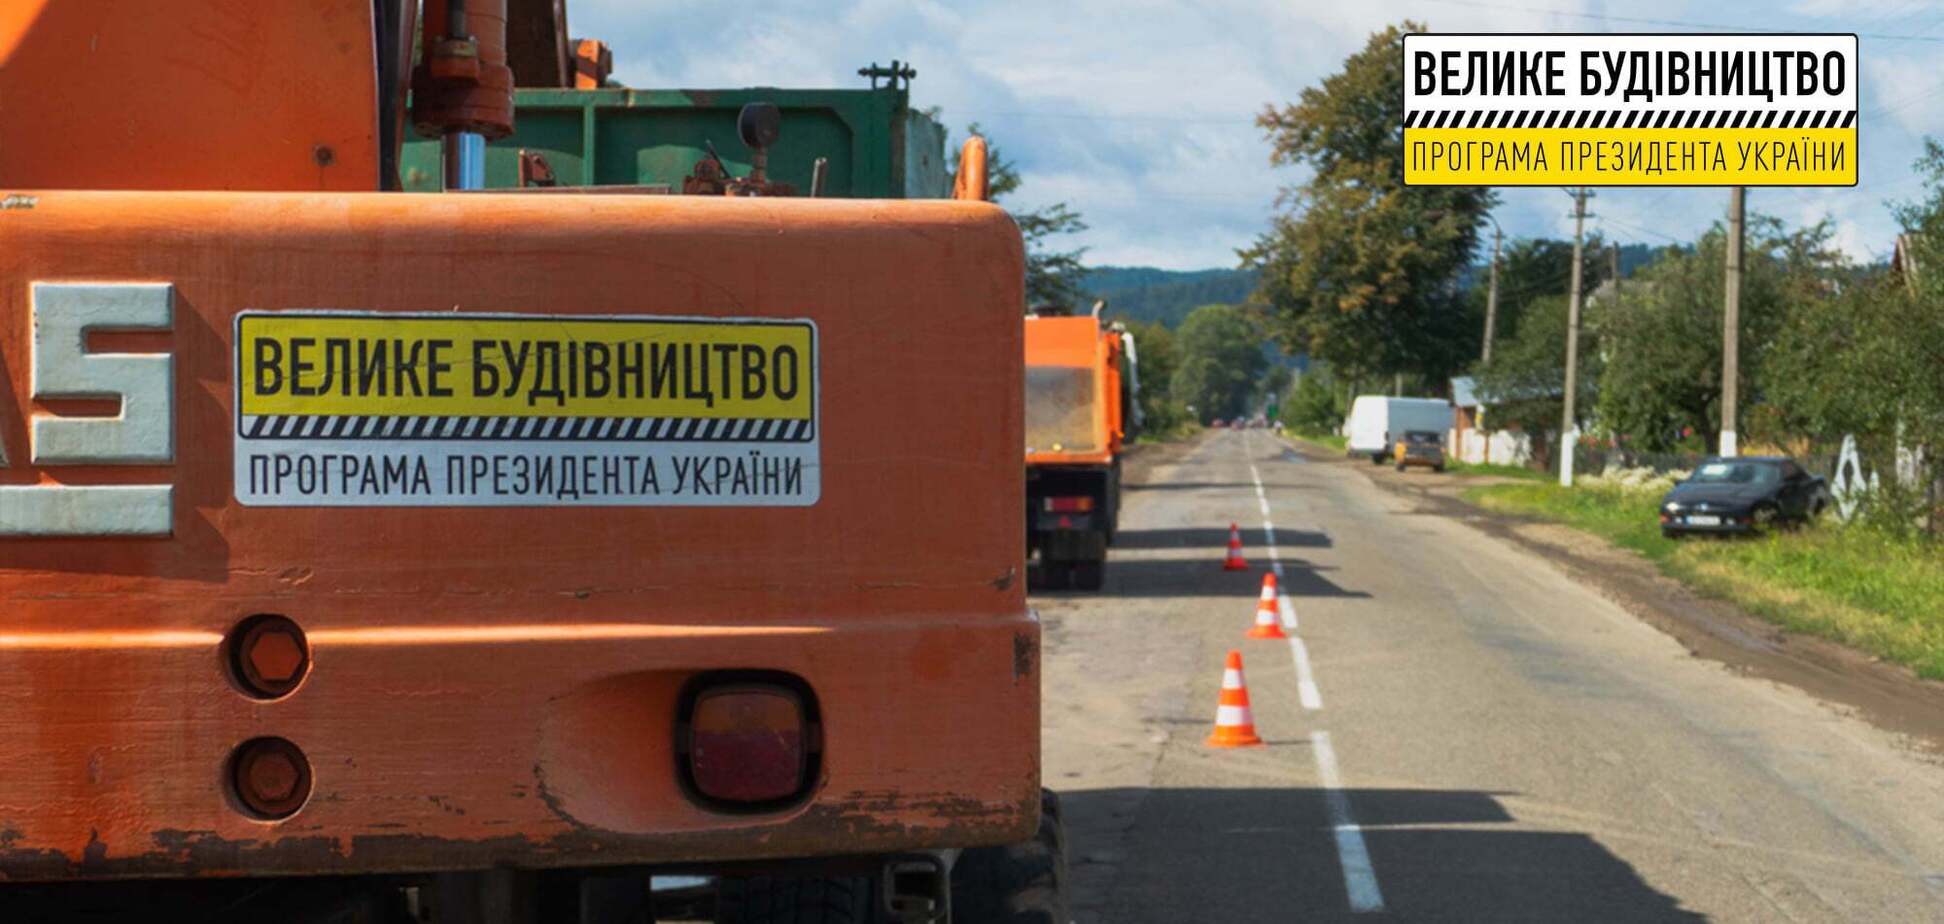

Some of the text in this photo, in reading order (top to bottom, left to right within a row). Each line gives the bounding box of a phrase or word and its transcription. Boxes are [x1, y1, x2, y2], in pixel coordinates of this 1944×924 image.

[0, 281, 175, 465] S
[253, 337, 800, 407] ВЕЛИКЕ БУДІВНИЦТВО
[250, 449, 802, 499] ПРОГРАМА ПРЕЗИДЕНТА УКРАЇНИ
